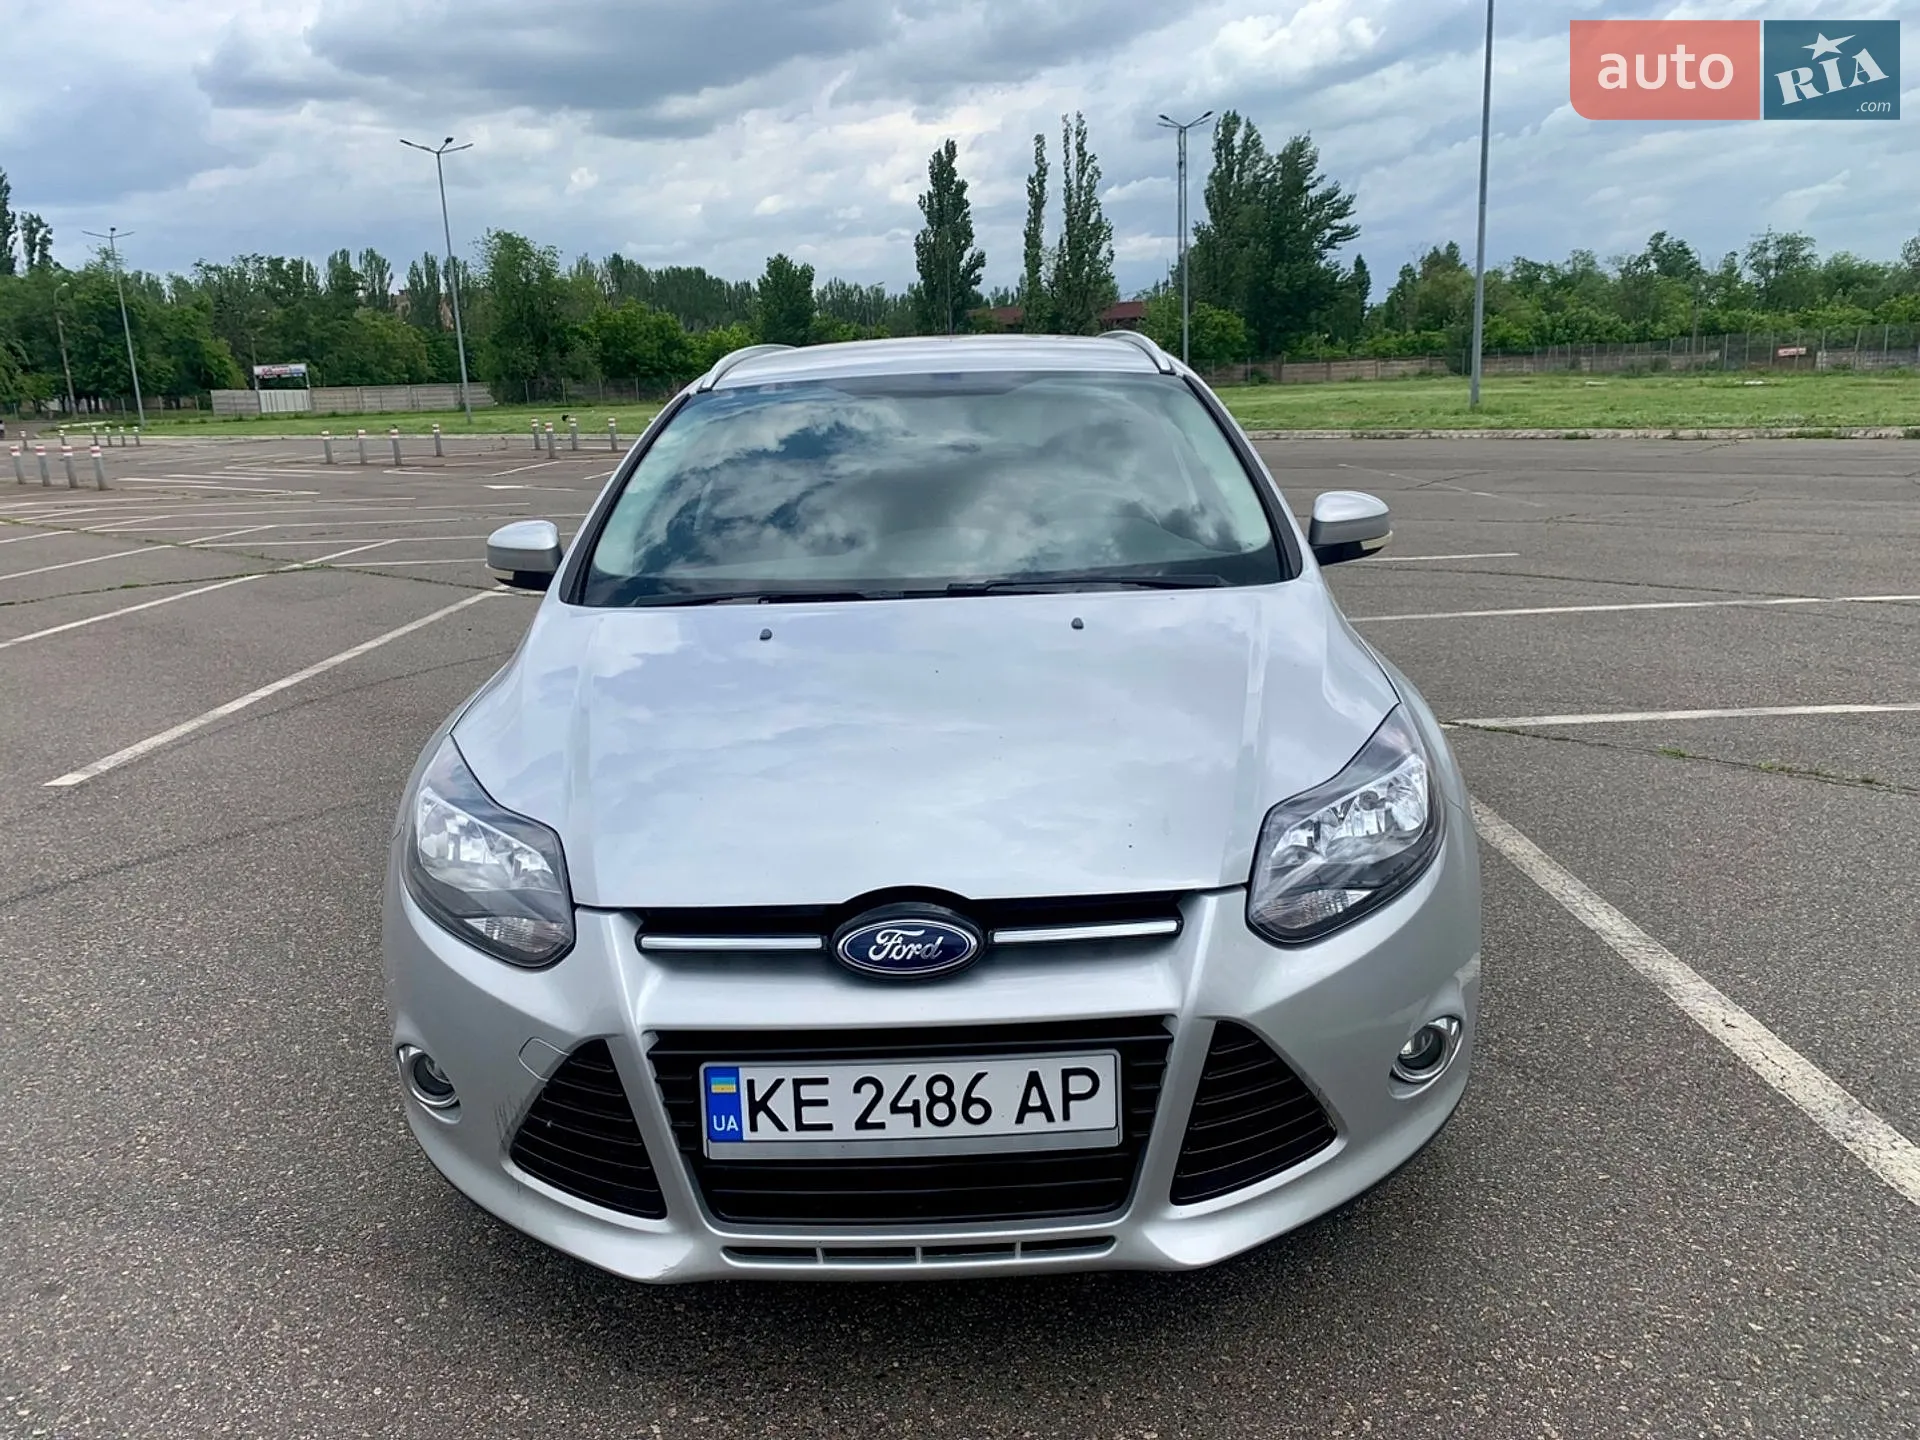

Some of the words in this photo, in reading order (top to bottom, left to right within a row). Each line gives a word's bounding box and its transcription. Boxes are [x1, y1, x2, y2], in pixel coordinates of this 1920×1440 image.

[868, 929, 943, 961] Ford
[746, 1077, 834, 1133] KE
[852, 1071, 993, 1130] 2486
[1014, 1066, 1101, 1125] AP
[713, 1115, 739, 1132] UA
